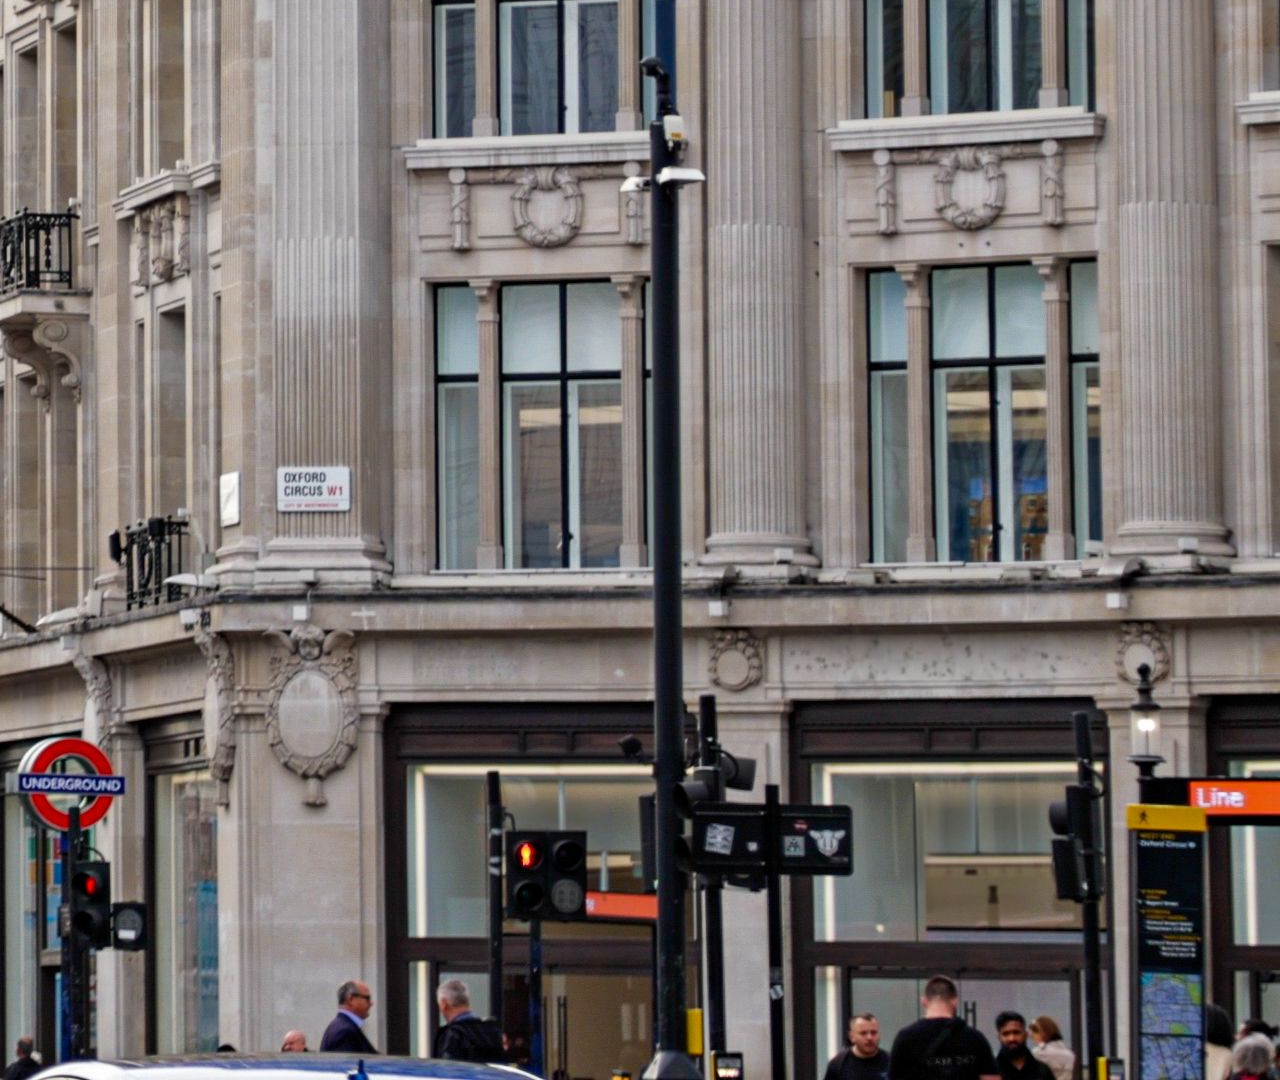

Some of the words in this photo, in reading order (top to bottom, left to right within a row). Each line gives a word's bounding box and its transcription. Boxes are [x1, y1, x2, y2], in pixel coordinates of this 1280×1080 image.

[283, 471, 327, 484] OXFORD
[283, 485, 324, 497] CIRCUS
[326, 485, 344, 497] W1
[21, 777, 122, 792] UNDERGROUND
[1196, 787, 1246, 808] Line
